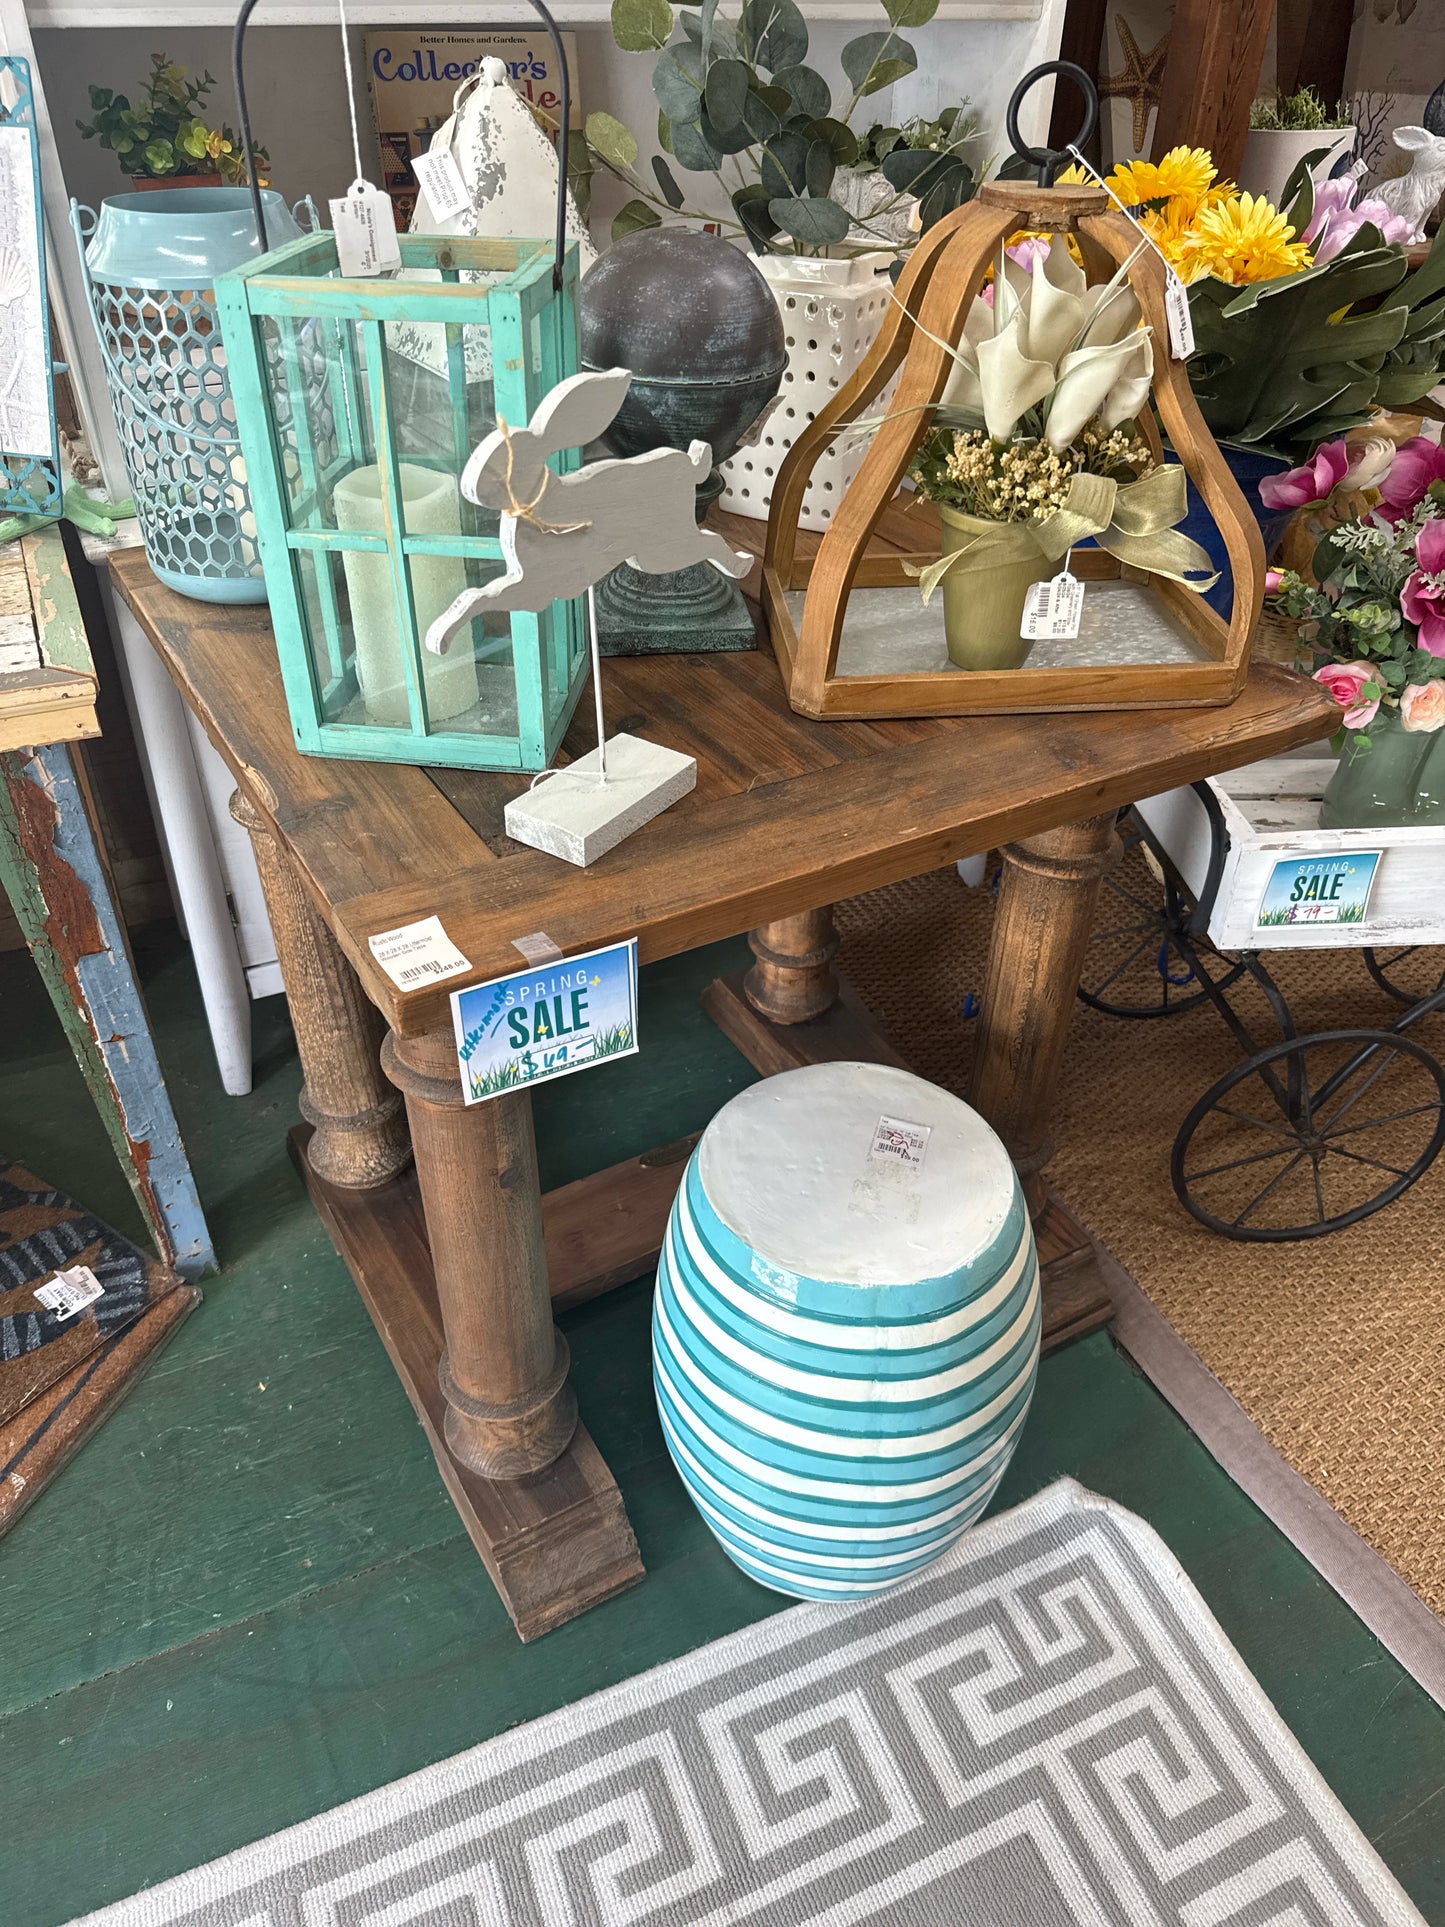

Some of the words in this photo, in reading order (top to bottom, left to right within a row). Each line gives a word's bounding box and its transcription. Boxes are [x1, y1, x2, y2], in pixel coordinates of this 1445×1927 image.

[373, 48, 547, 81] Collecr's
[435, 155, 445, 170] This
[423, 171, 444, 205] regulations
[428, 158, 437, 170] not
[433, 169, 443, 185] meet
[438, 185, 449, 200] Prop
[439, 170, 455, 193] product
[449, 192, 459, 205] may
[1298, 862, 1348, 874] SPRING
[1290, 873, 1345, 901] SALE
[387, 932, 403, 943] Wood
[505, 969, 587, 1005] SPRING
[507, 987, 589, 1049] SALE
